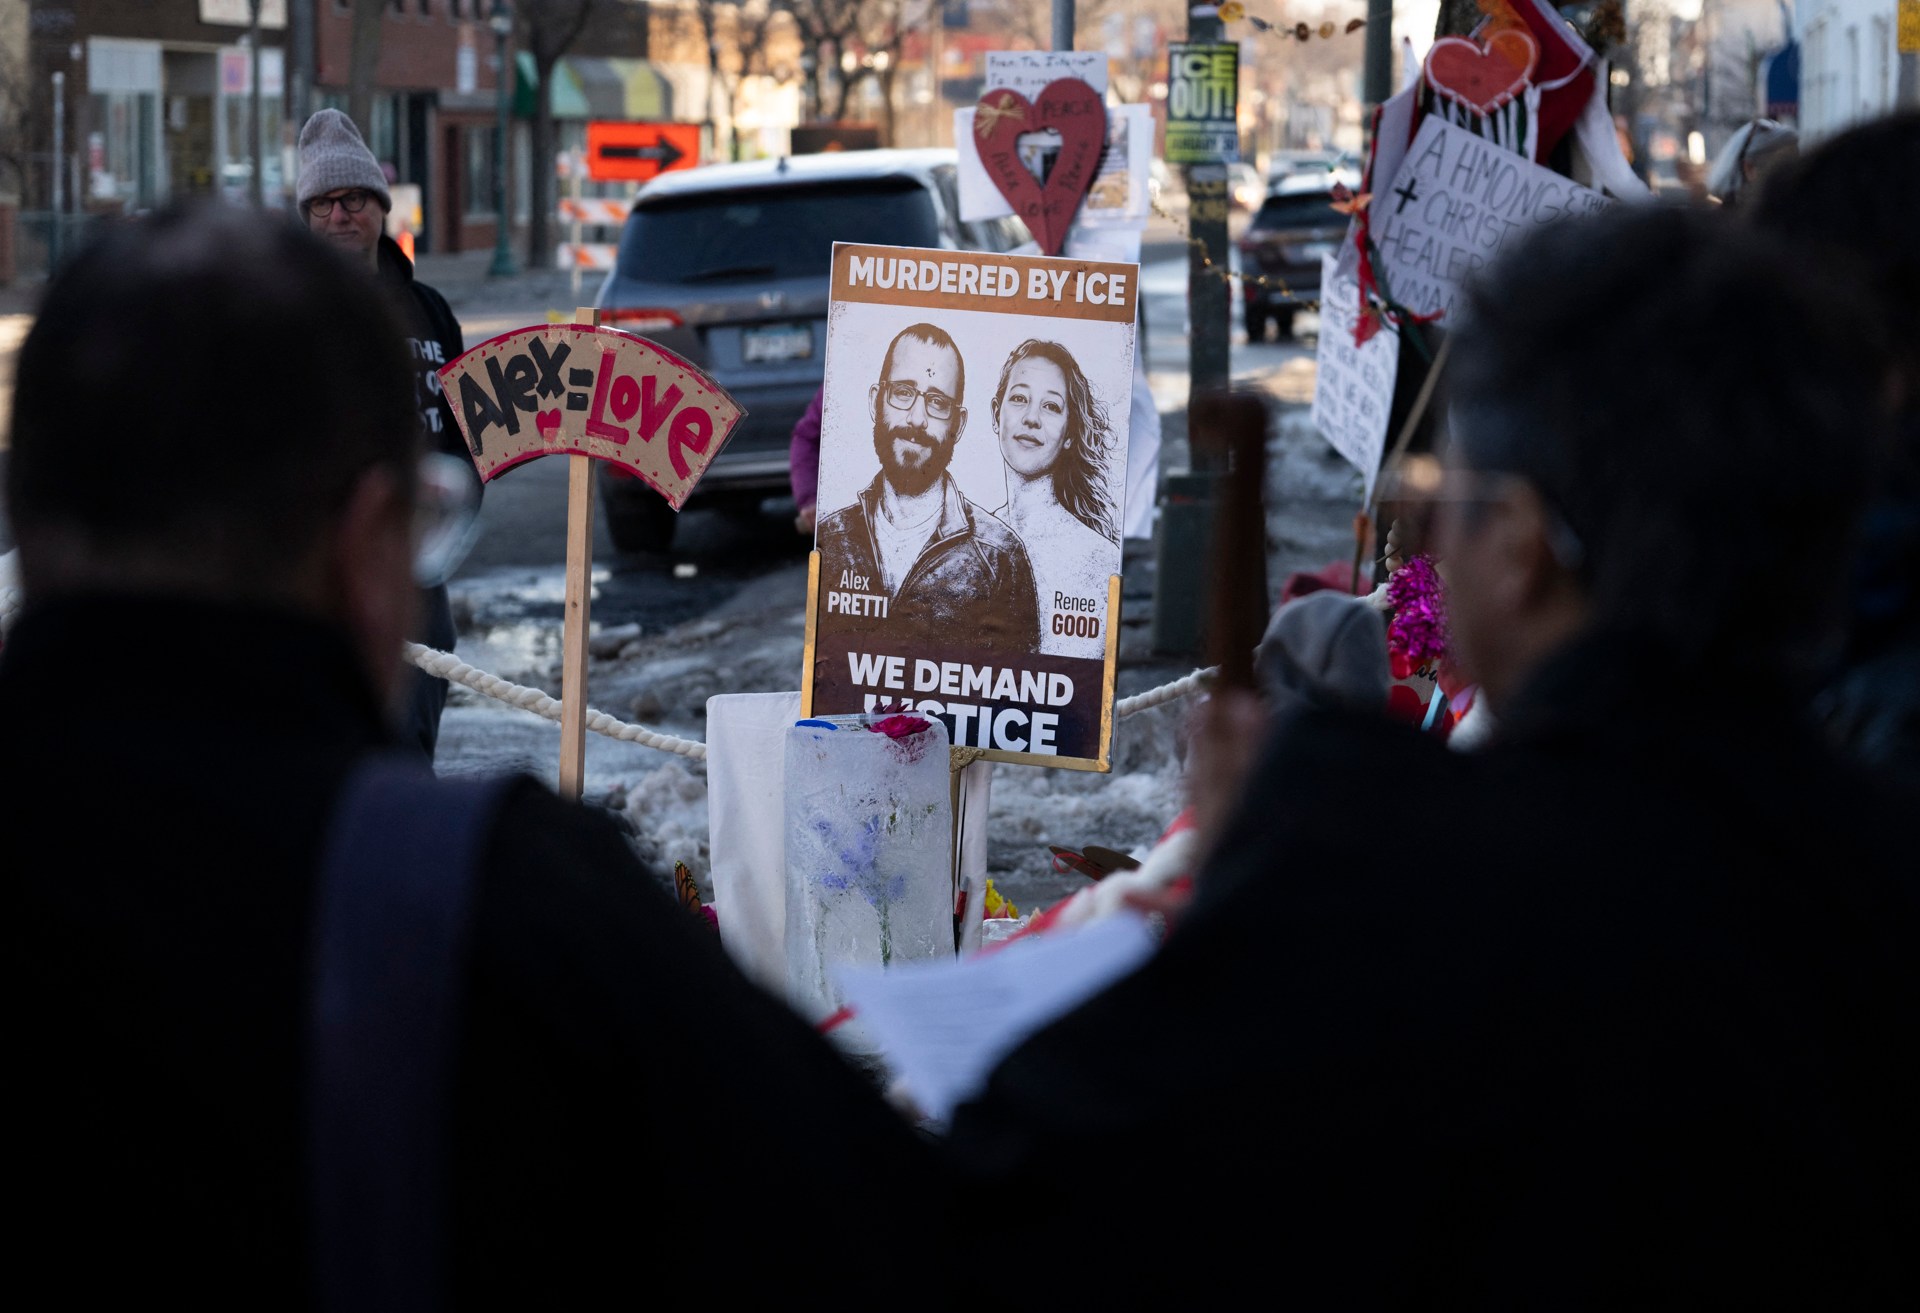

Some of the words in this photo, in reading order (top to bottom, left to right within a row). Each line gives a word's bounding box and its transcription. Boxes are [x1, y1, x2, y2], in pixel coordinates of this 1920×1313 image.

[1171, 53, 1236, 78] ICE
[1170, 80, 1236, 119] OUT!
[1414, 128, 1447, 179] A
[1450, 141, 1562, 223] HMONG
[1423, 190, 1522, 255] CHRIST
[1380, 215, 1485, 288] HEALER
[848, 255, 1020, 297] MURDERED
[1027, 268, 1070, 301] BY
[1075, 271, 1127, 306] ICE
[839, 569, 870, 591] Alex
[827, 591, 889, 619] PRETTI
[1054, 590, 1096, 613] Renee
[1052, 613, 1100, 639] GOOD
[847, 652, 906, 690] WE
[914, 659, 1074, 706] DEMAND
